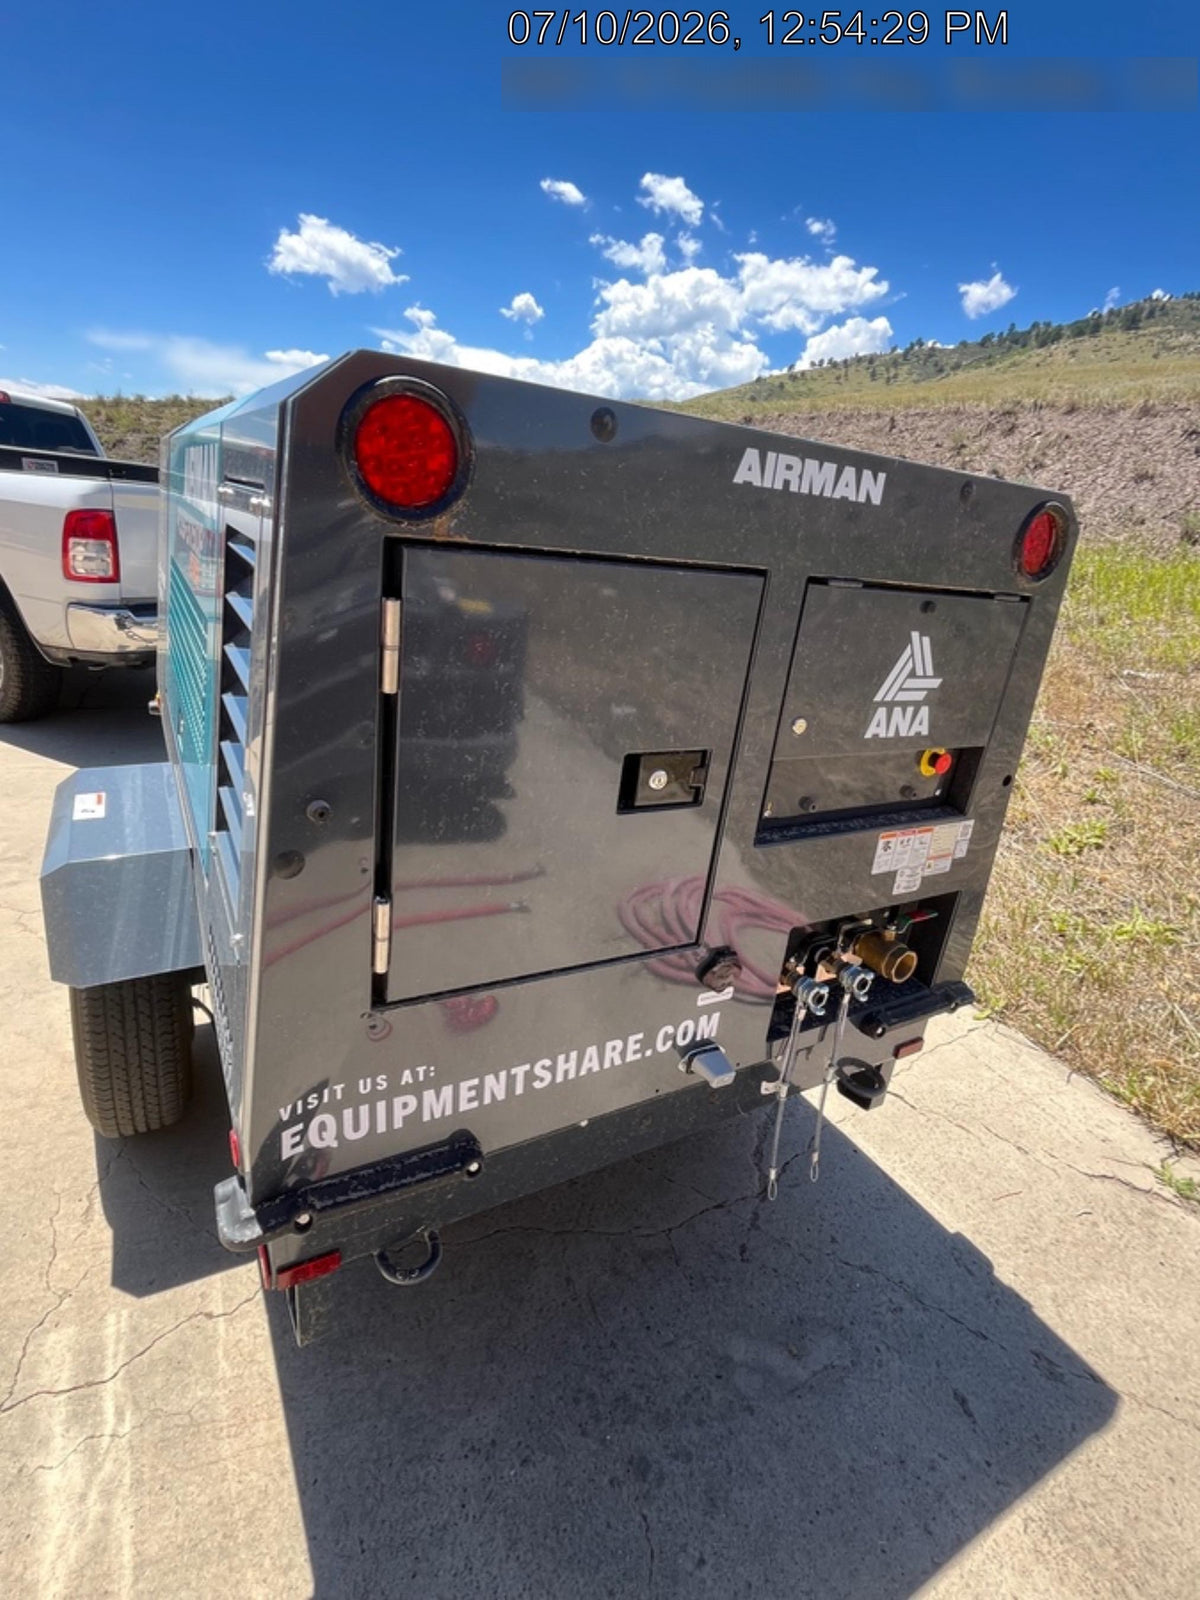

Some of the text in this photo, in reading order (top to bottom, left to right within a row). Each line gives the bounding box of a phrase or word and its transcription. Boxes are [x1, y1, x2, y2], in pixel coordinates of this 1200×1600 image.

[733, 448, 887, 505] AIRMAN
[864, 705, 929, 738] ANA
[279, 1066, 435, 1121] VISIT US AT:
[281, 1012, 721, 1161] EQUIPMENTSHARE.COM
